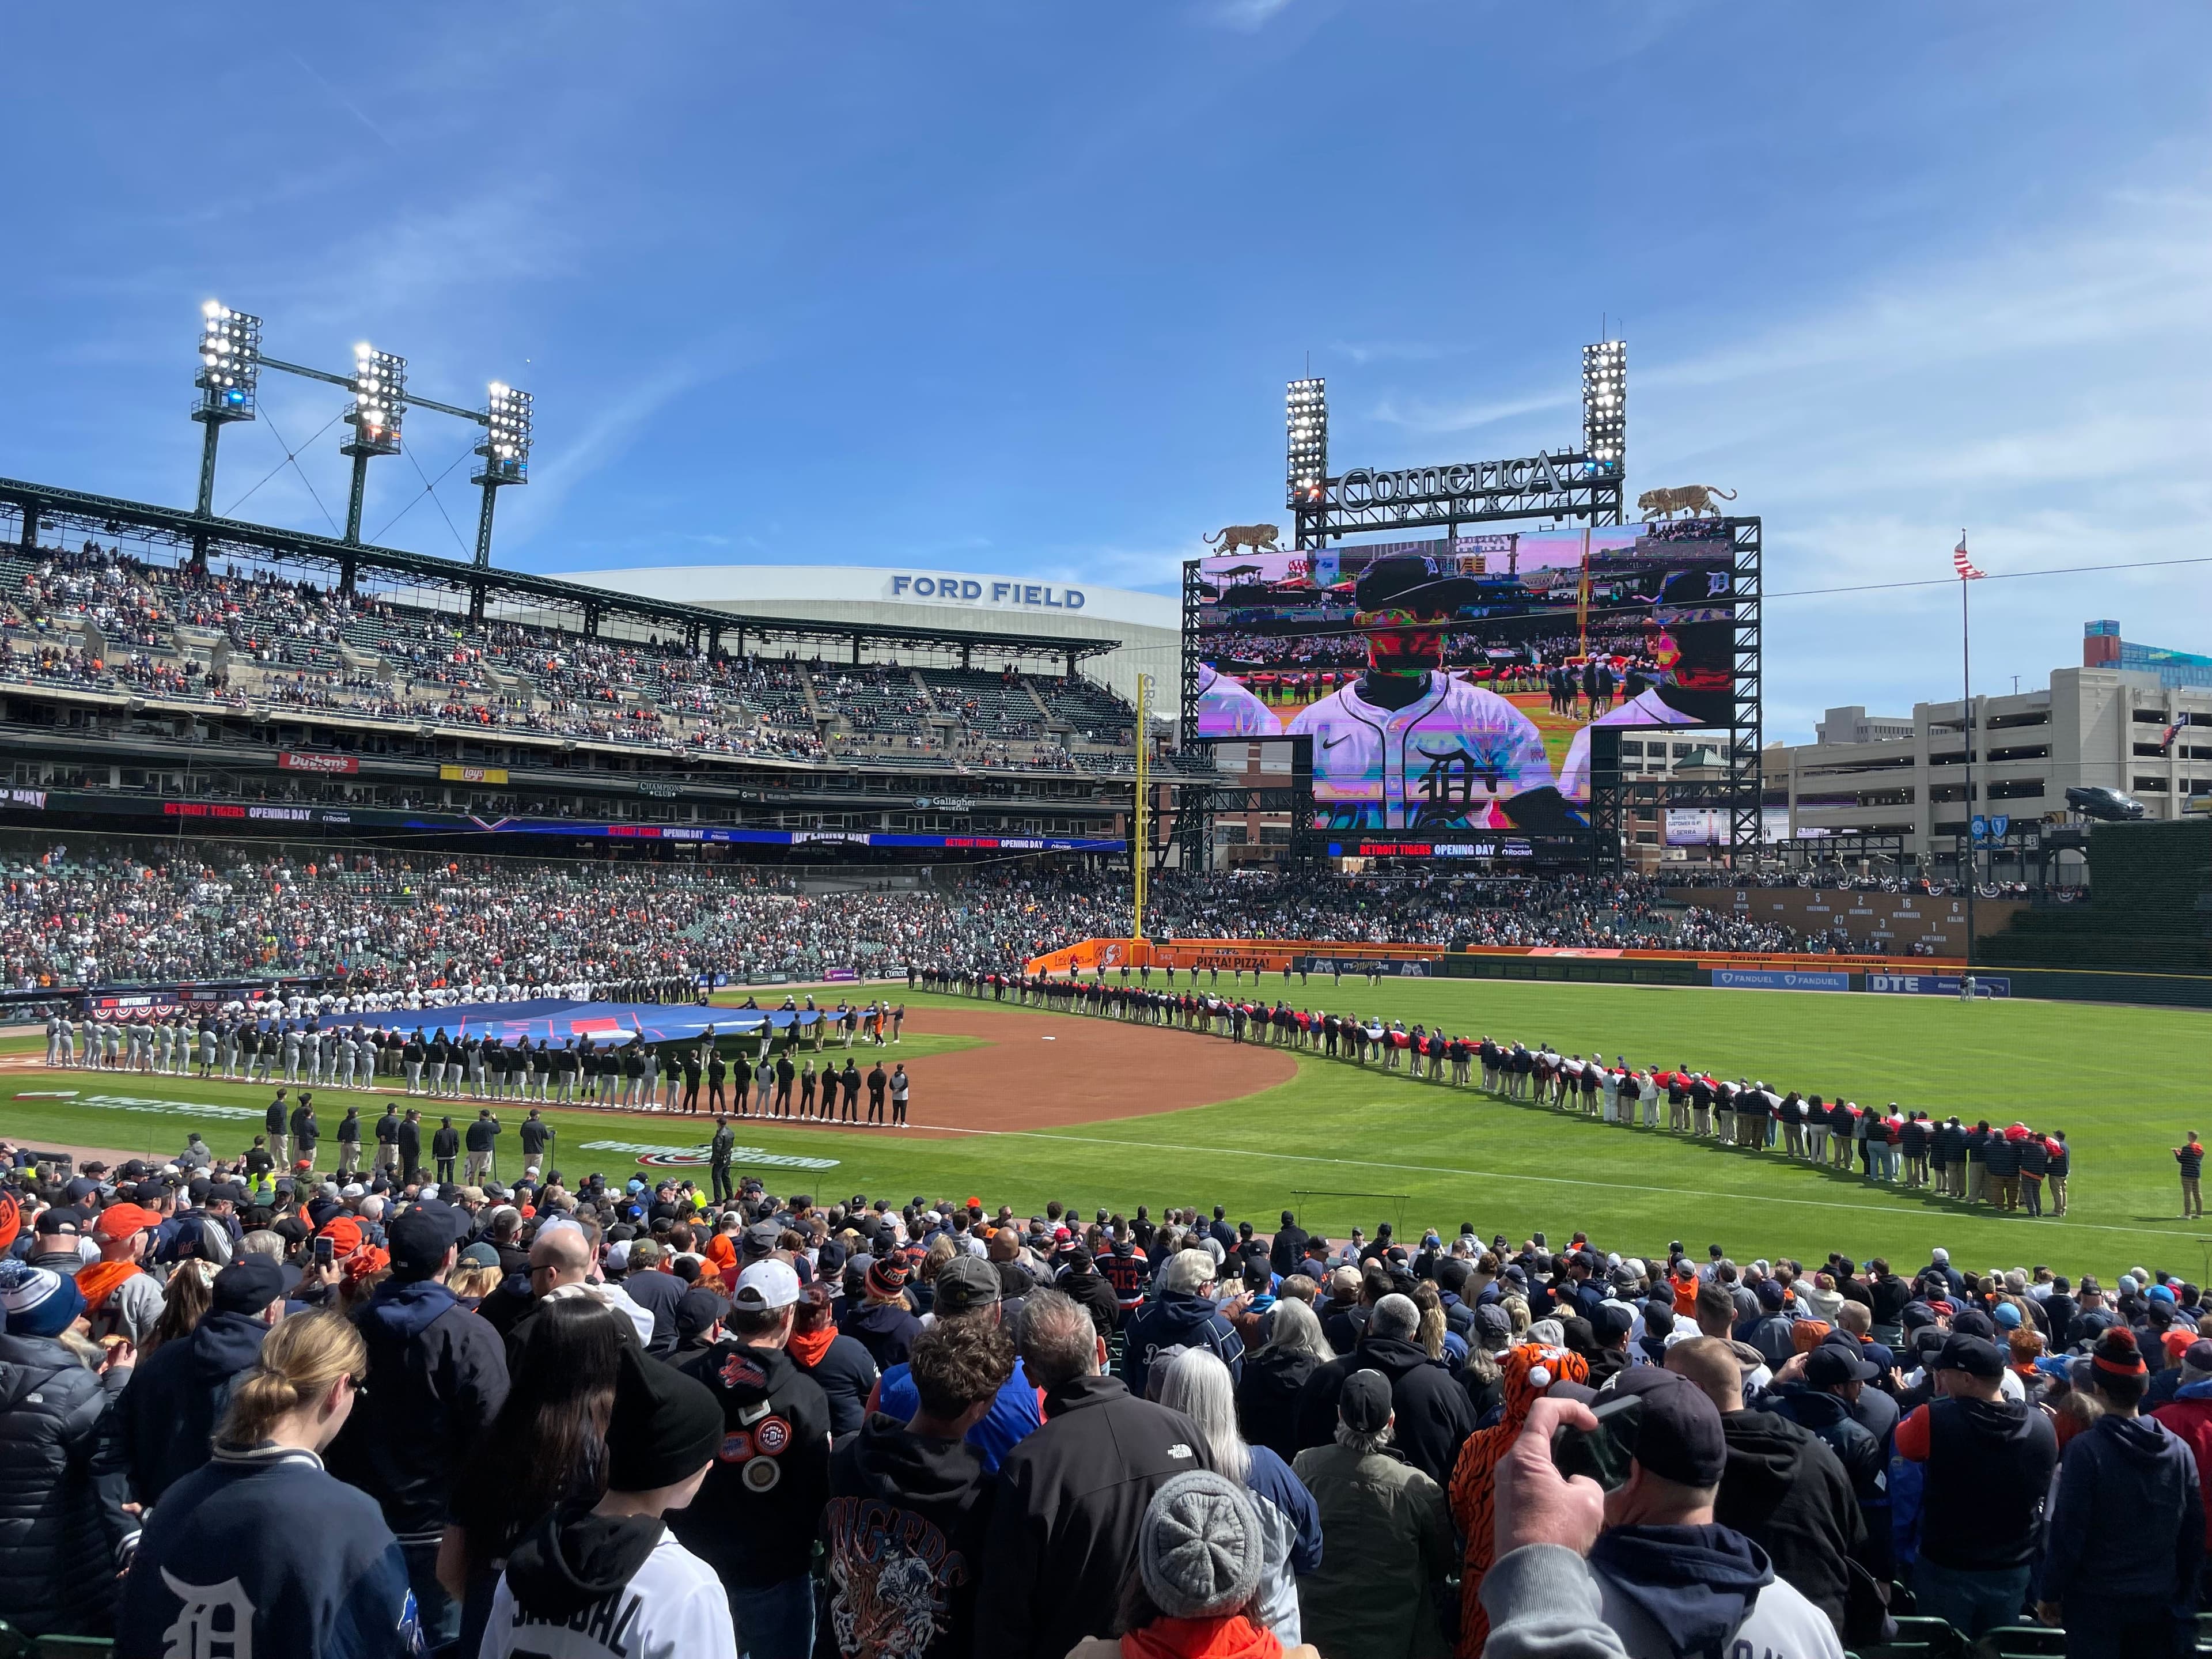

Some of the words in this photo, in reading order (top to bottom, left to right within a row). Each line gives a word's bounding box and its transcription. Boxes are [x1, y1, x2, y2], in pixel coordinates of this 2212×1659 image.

[1397, 495, 1501, 520] PARK
[893, 576, 982, 599] FORD
[992, 582, 1085, 609] FIELD
[289, 753, 349, 768] Dunham's
[640, 782, 684, 793] CHAMPIONS
[933, 797, 976, 807] Gallagher
[249, 807, 290, 819] OPENING
[291, 809, 311, 820] DAY
[663, 828, 691, 838] OPENING
[691, 830, 704, 839] DAY
[1001, 839, 1029, 849] OPENING
[1029, 840, 1043, 849] DAY
[1359, 844, 1397, 855] DETROIT
[1399, 844, 1431, 855] TIGERS
[1434, 844, 1474, 855] OPENING
[1475, 844, 1495, 855] DAY
[1736, 892, 1746, 902] 23
[1815, 893, 1821, 903] 5
[1858, 896, 1863, 906] 2
[1902, 898, 1911, 908] 16
[1952, 902, 1959, 912] 6
[1834, 915, 1844, 925] 47
[1880, 918, 1885, 929] 3
[1931, 922, 1936, 932] 1
[1196, 956, 1231, 967] PIZZA!
[1234, 957, 1270, 968] PIZZA!
[1735, 975, 1774, 983] FANDUEL
[1798, 977, 1839, 986] FANDUEL
[1873, 976, 1919, 992] DTE
[119, 997, 151, 1006] DIFFERENT
[85, 1096, 268, 1116] VICTORS
[578, 1141, 711, 1158] OPENING
[730, 1152, 841, 1168] EEKEND
[1107, 1269, 1138, 1290] 313
